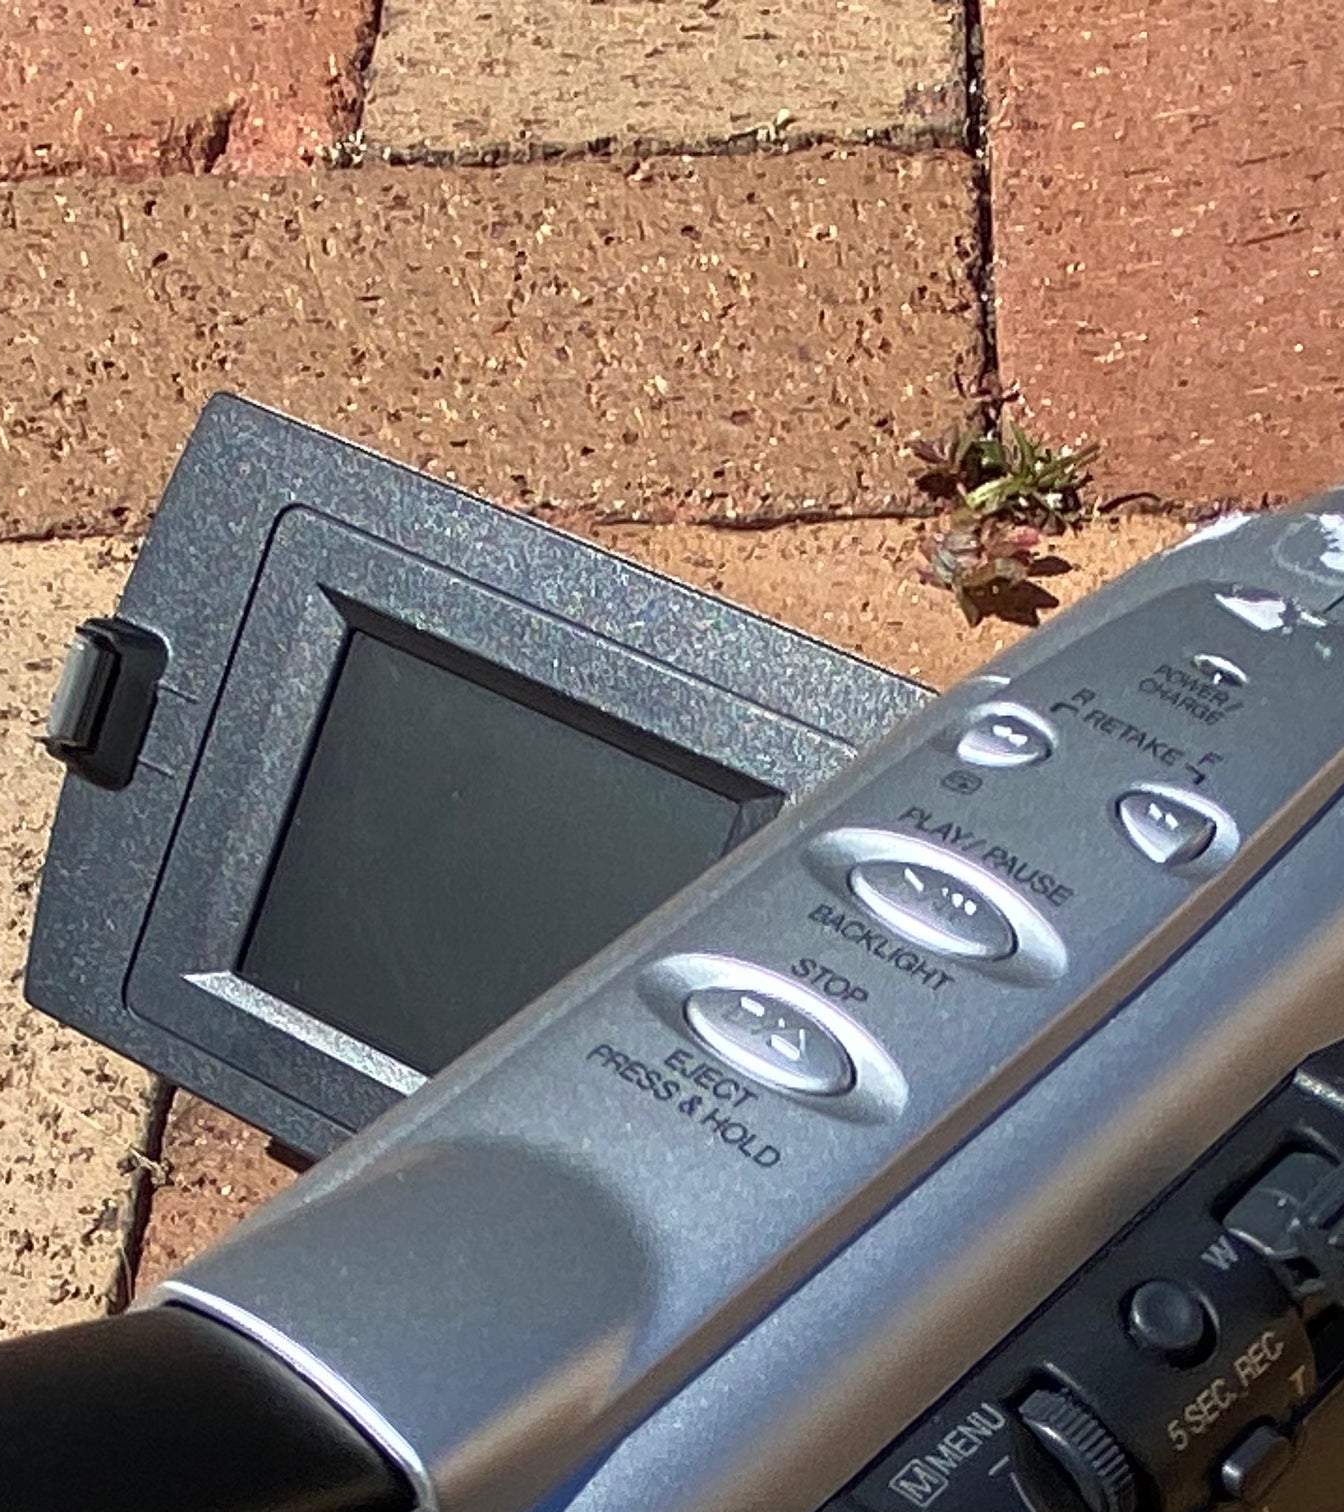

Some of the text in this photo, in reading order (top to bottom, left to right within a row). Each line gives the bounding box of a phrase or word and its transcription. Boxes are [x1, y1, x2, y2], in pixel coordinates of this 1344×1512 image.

[1071, 687, 1097, 706] R
[1138, 677, 1226, 726] CHARGE
[1083, 709, 1189, 767] RETAKE
[1199, 752, 1224, 769] F
[808, 904, 955, 992] BACKLIGHT
[790, 957, 870, 1005] STOP
[663, 1048, 761, 1109] EJECT
[586, 1044, 783, 1168] PRESS & HOLD
[1200, 1235, 1240, 1272] W
[1167, 1422, 1190, 1452] 5
[1234, 1331, 1285, 1382] REC
